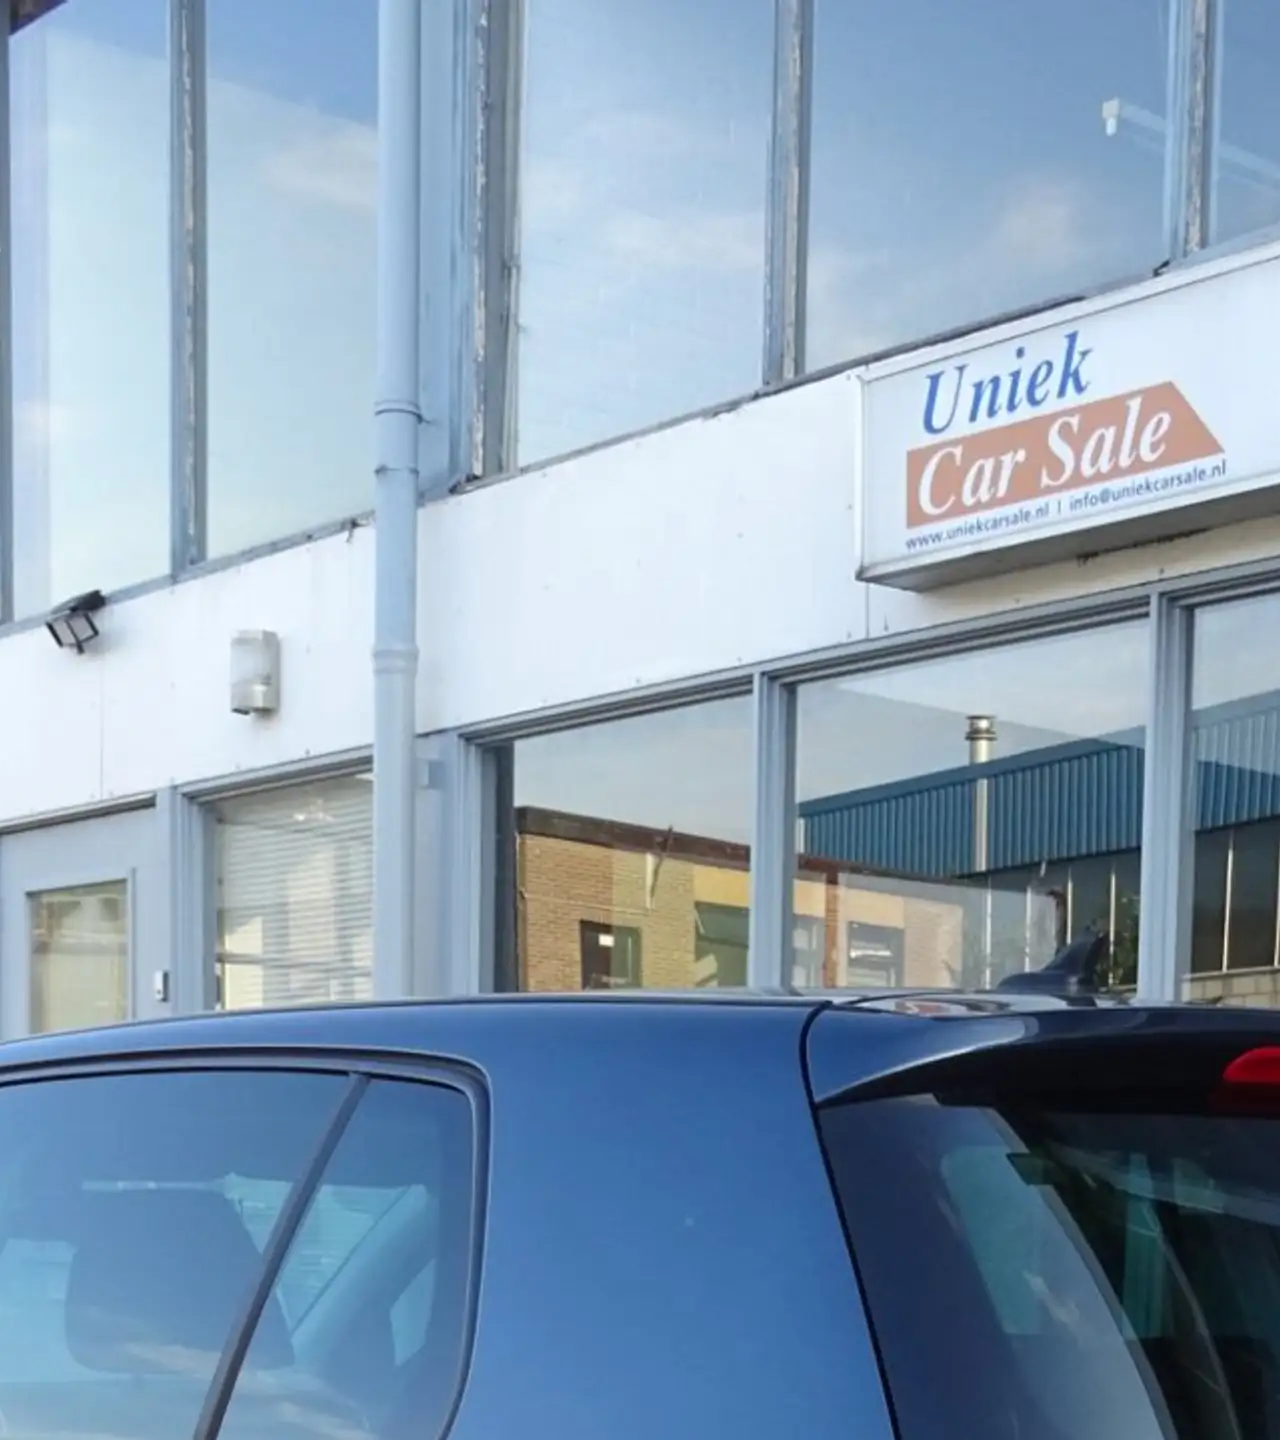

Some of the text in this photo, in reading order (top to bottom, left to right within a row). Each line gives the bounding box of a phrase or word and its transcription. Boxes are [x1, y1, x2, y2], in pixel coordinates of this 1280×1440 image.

[922, 330, 1093, 435] Uniek
[905, 502, 1050, 550] www.uniekcarsale.nl
[1070, 458, 1227, 512] info@uniekcarsale.nl
[918, 396, 1171, 516] Car Sale
